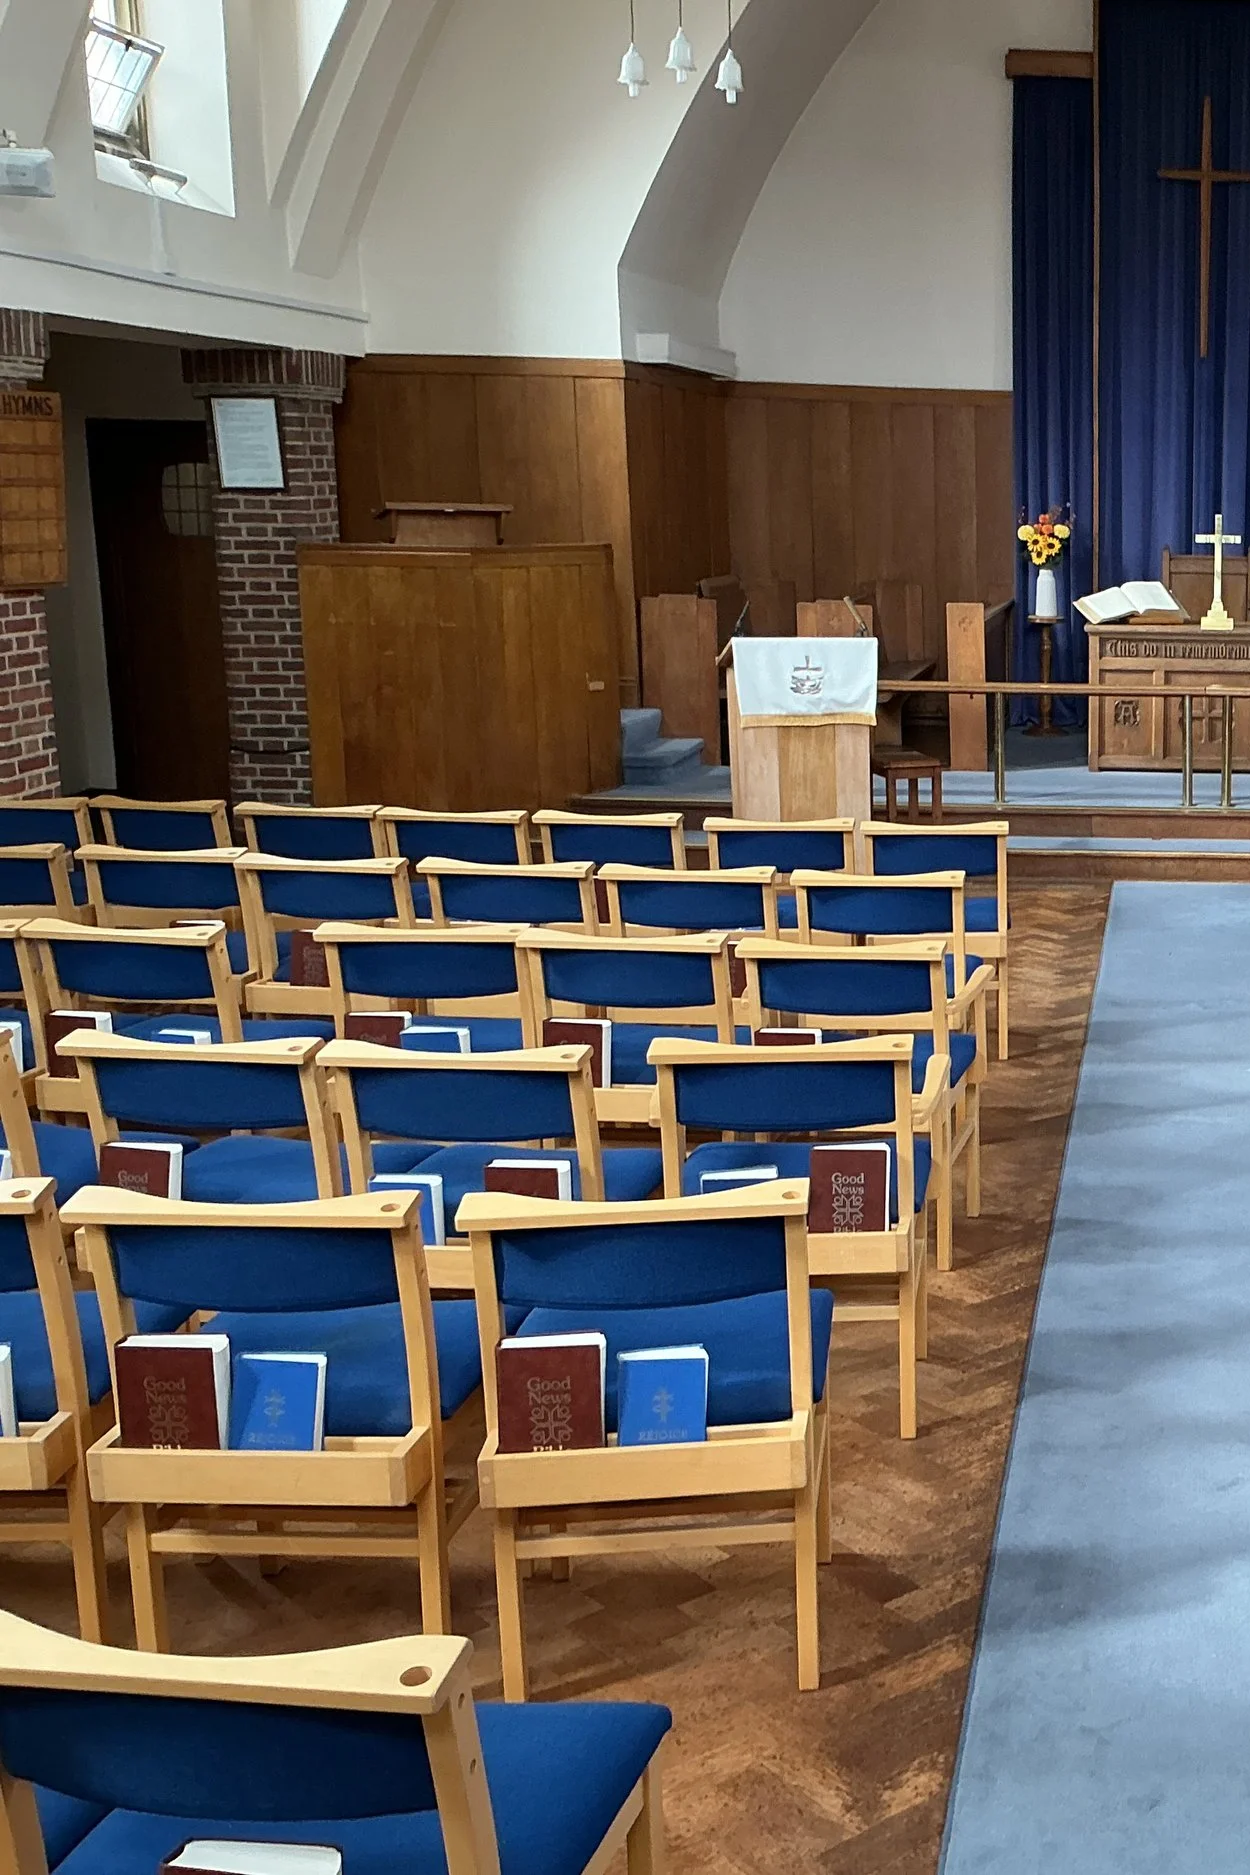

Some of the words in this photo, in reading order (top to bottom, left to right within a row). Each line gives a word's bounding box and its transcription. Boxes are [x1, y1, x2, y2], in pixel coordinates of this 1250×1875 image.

[2, 394, 53, 416] HYMNS
[1106, 639, 1137, 656] This
[118, 1169, 149, 1184] Good
[832, 1172, 865, 1184] Good
[832, 1183, 865, 1195] News
[143, 1376, 186, 1391] Good
[527, 1376, 571, 1392] Good
[528, 1391, 572, 1406] News
